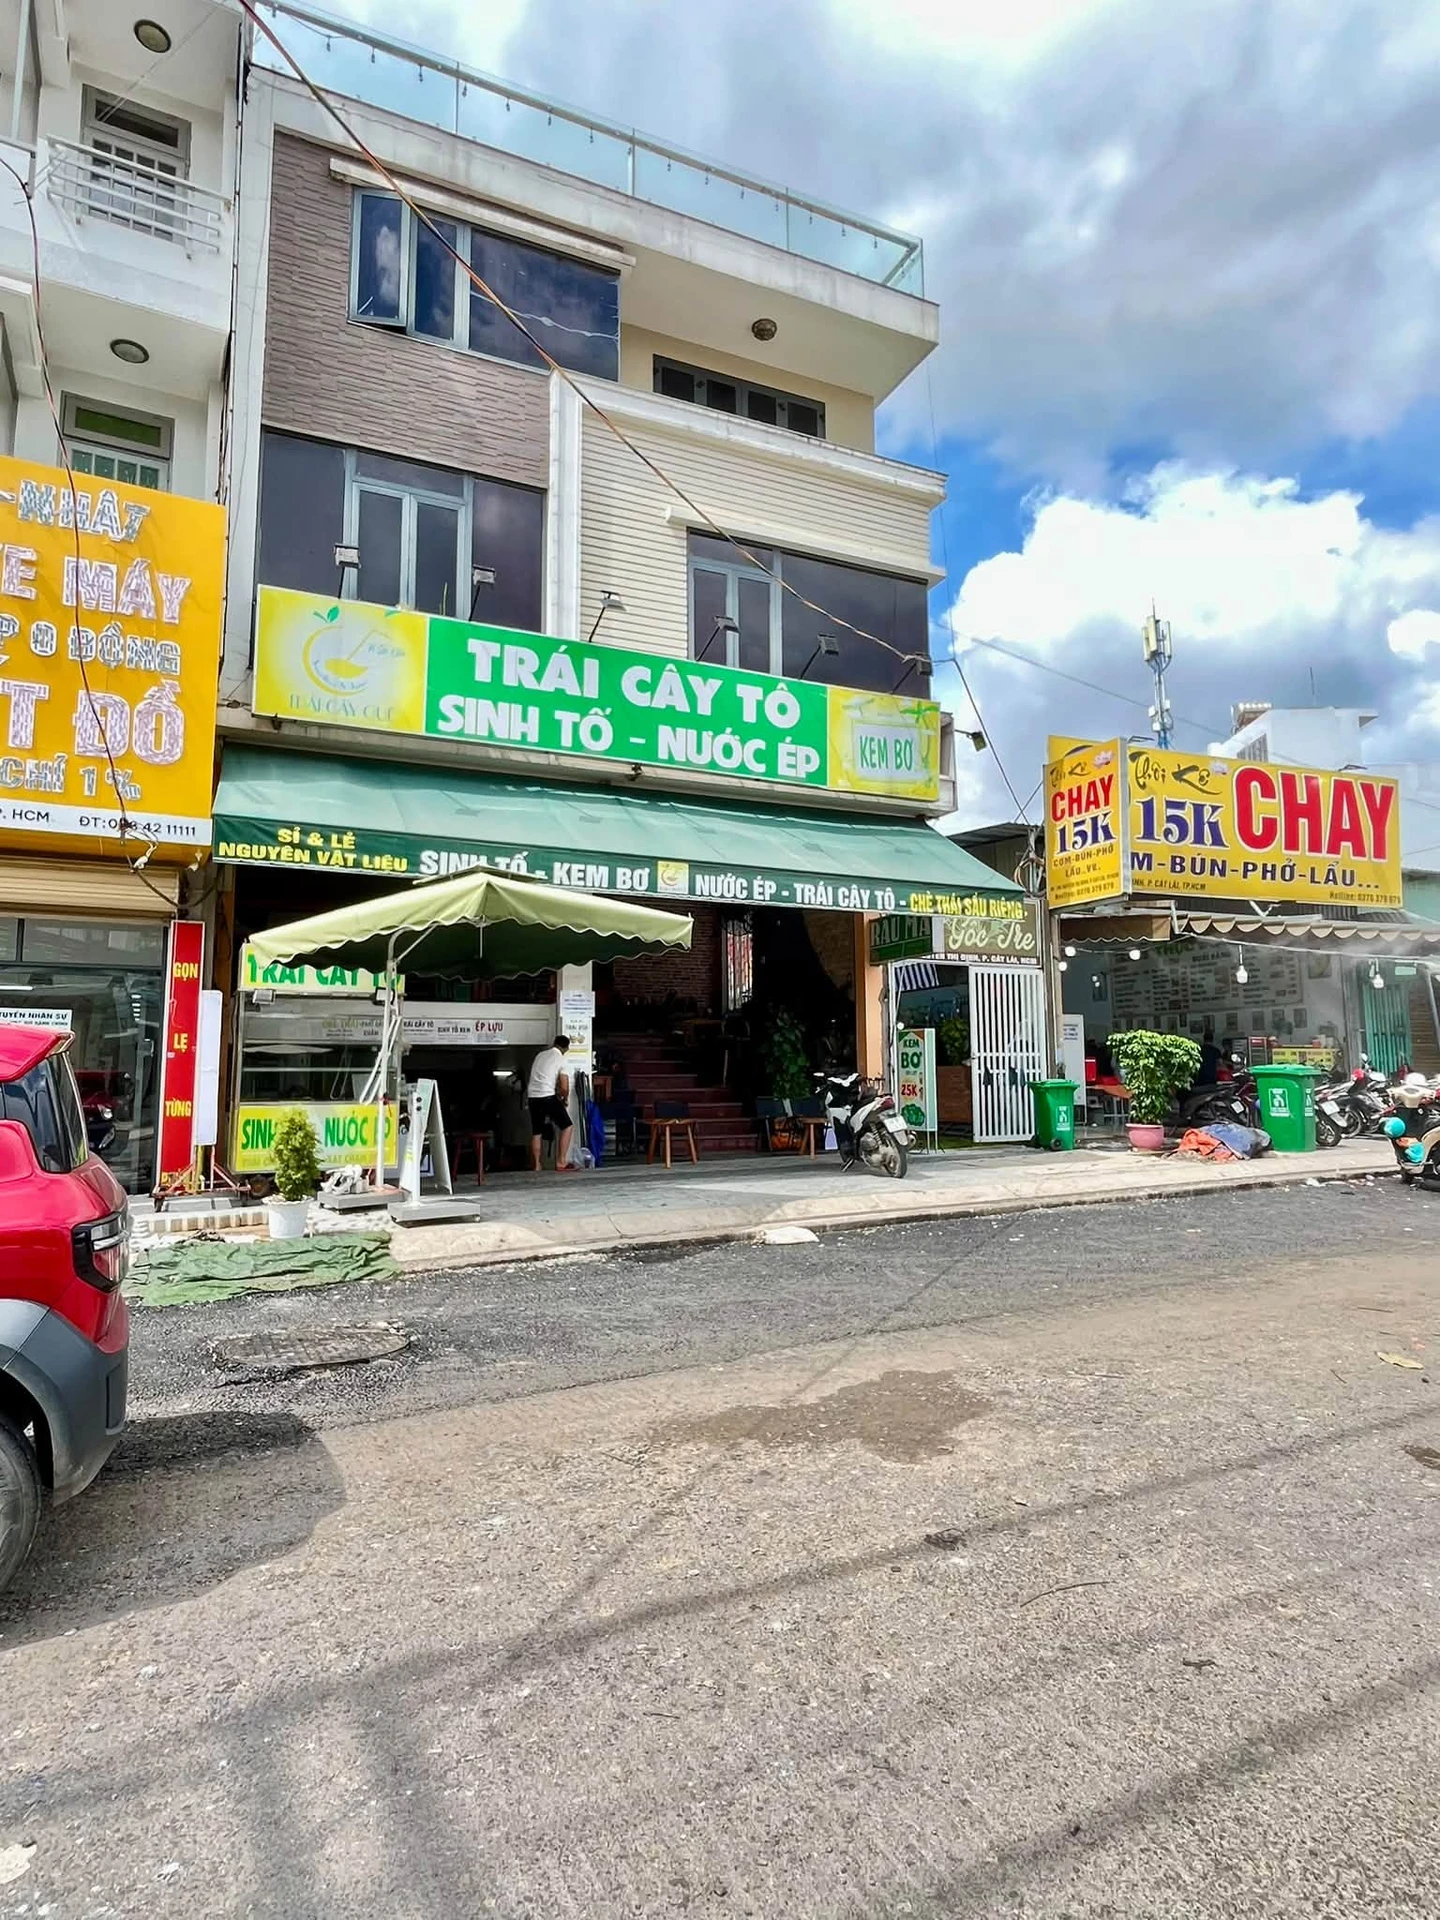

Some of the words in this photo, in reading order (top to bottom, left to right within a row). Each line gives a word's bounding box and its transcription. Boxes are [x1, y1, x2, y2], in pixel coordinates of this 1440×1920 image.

[62, 557, 191, 625] MÁY
[467, 637, 600, 699] TRÁI
[621, 663, 723, 716] CÂY
[736, 682, 801, 729] TÔ
[437, 694, 540, 744] SINH
[554, 706, 614, 752] TỐ
[657, 724, 767, 775] NƯỚC
[777, 736, 820, 779] ÉP
[860, 734, 888, 769] KEM
[894, 738, 913, 771] BƠ
[79, 765, 97, 797] 1
[1051, 773, 1114, 822] CHAY
[12, 808, 50, 822] HCM
[1135, 797, 1229, 849] 15K
[1234, 766, 1395, 862] CHAY
[307, 832, 323, 847] &
[1056, 810, 1117, 855] 15K
[219, 841, 310, 863] NGUYÊN
[553, 861, 609, 889] KEM
[615, 867, 649, 891] BƠ
[695, 873, 748, 899] NƯỚC
[752, 876, 777, 901] ÉP
[793, 881, 833, 906] TRÁI
[837, 884, 870, 909] CÂY
[874, 887, 895, 910] TÔ
[910, 891, 934, 913] CHÈ
[173, 962, 198, 981] GỌN
[475, 1020, 486, 1032] ÉP
[174, 1033, 188, 1052] LẸ
[901, 1052, 922, 1069] BƠ
[901, 1084, 917, 1096] 25K
[165, 1098, 192, 1117] TỪNG
